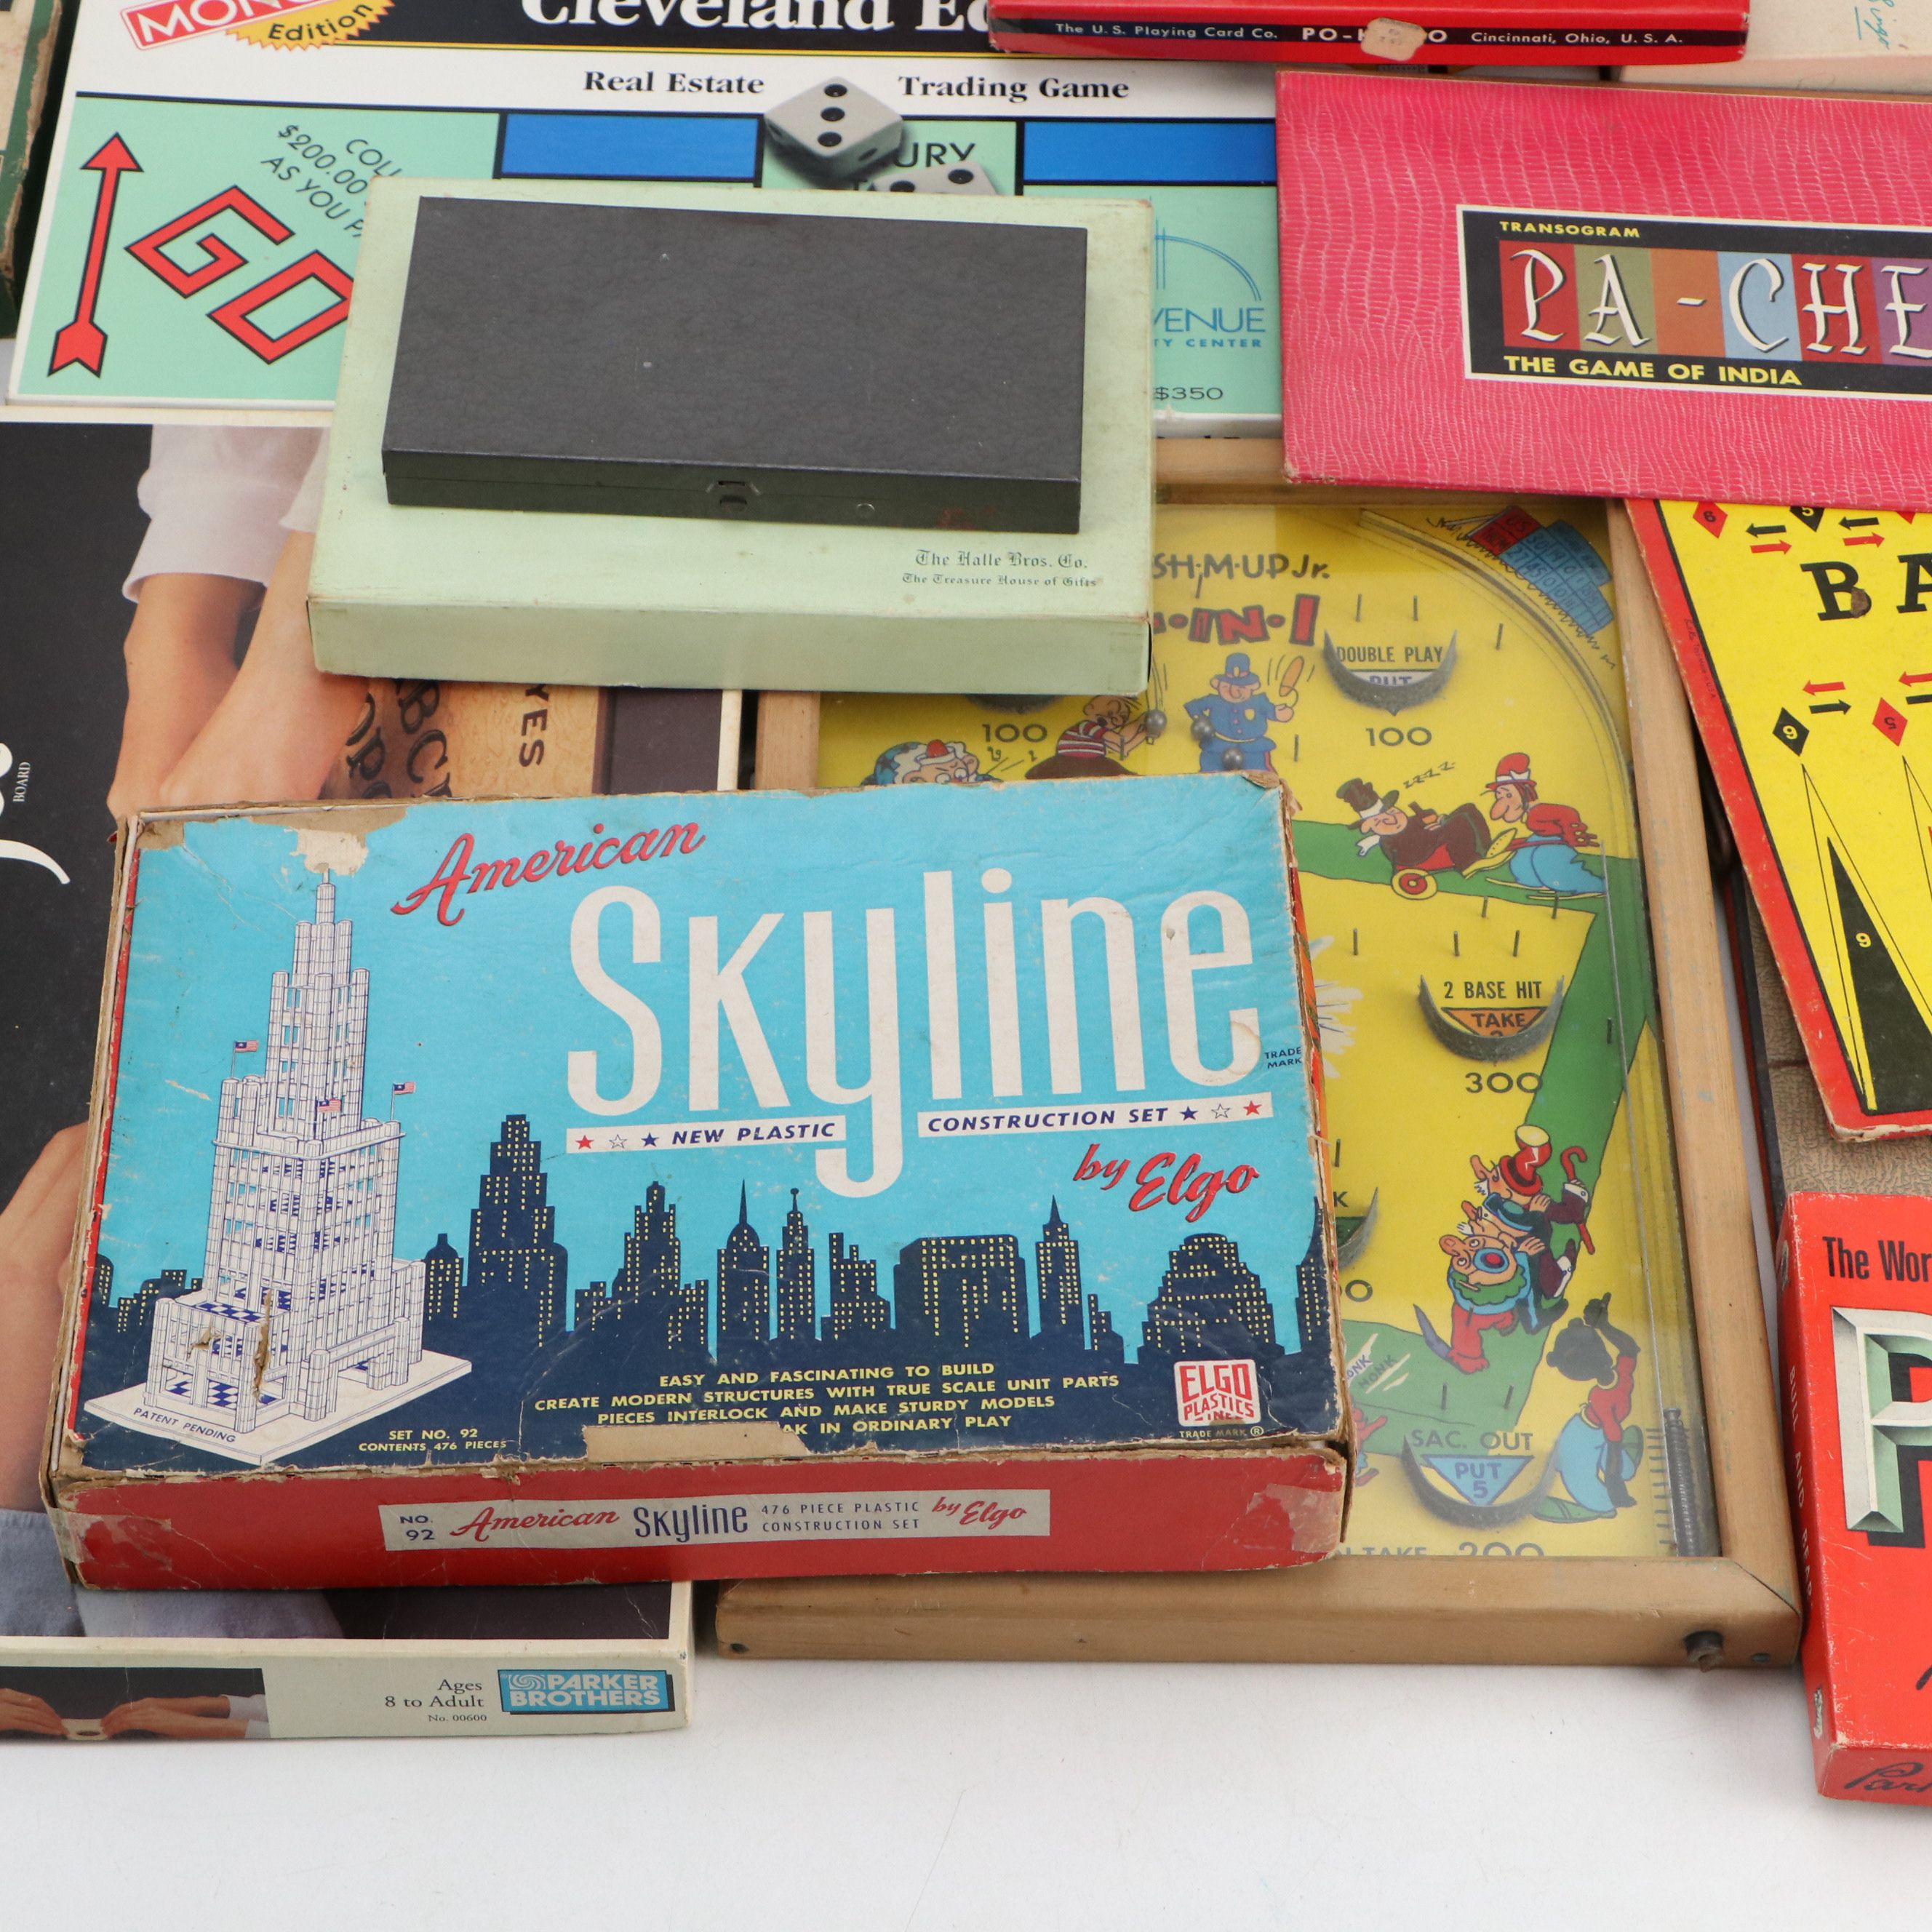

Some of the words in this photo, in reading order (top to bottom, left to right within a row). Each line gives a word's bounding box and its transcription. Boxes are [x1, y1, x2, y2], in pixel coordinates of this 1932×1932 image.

[268, 3, 374, 41] Edition
[1056, 23, 1083, 34] The
[1135, 26, 1197, 38] Playing
[1205, 27, 1244, 38] Card
[1252, 28, 1278, 39] Co.
[1471, 32, 1557, 44] Cincinnati,
[1565, 33, 1610, 44] Ohio,
[583, 71, 654, 92] Real
[667, 73, 765, 95] Estate
[898, 76, 1028, 103] Trading
[1039, 78, 1129, 100] Game
[278, 124, 368, 194] $200.00
[260, 157, 300, 180] AS
[295, 178, 351, 219] YOU
[1499, 221, 1640, 239] TRANSOGRAM
[124, 185, 356, 365] GO
[1186, 339, 1262, 348] CENTER
[1504, 355, 1556, 374] THE
[1568, 358, 1655, 379] GAME
[1668, 364, 1705, 382] OF
[1719, 365, 1803, 386] INDIA
[1154, 387, 1224, 401] $350
[915, 549, 949, 566] The
[957, 551, 1002, 567] Halle
[1008, 551, 1053, 567] Bros.
[1058, 553, 1087, 568] Co.
[902, 573, 927, 583] The
[933, 574, 992, 585] Treasure
[997, 575, 1039, 586] House
[1045, 575, 1058, 586] of
[1336, 646, 1395, 663] DOUBLE
[1404, 646, 1443, 663] PLAY
[518, 684, 550, 767] YES
[981, 723, 1047, 743] 100
[1365, 727, 1432, 746] 100
[12, 762, 31, 802] BOARD
[390, 822, 706, 927] American
[1443, 981, 1453, 999] 2
[1464, 981, 1506, 999] BASE
[1516, 981, 1541, 999] HIT
[1470, 1013, 1525, 1028] TAKE
[567, 868, 1261, 1198] Skyline
[1264, 1046, 1302, 1059] TRADE
[1267, 1057, 1302, 1069] MARK
[1465, 1072, 1543, 1093] 300
[671, 1128, 724, 1145] NEW
[737, 1122, 836, 1142] PLASTIC
[927, 1109, 1115, 1133] CONSTRUCTION
[1128, 1106, 1168, 1123] SET
[1073, 1143, 1131, 1190] by
[1128, 1151, 1261, 1223] Elgo
[1822, 1236, 1869, 1280] The
[1877, 1240, 1932, 1282] Wor
[660, 1374, 706, 1387] EASY
[717, 1372, 759, 1385] AND
[770, 1366, 894, 1384] FASCINATING
[905, 1365, 930, 1378] TO
[942, 1362, 994, 1376] BUILD
[1179, 1363, 1253, 1404] ELGO
[535, 1396, 600, 1411] CREATE
[611, 1392, 693, 1408] MODERN
[704, 1387, 815, 1404] STRUCTURES
[826, 1385, 876, 1400] WITH
[887, 1383, 931, 1397] TRUE
[942, 1380, 996, 1394] SCALE
[1007, 1377, 1051, 1392] UNIT
[1062, 1375, 1119, 1389] PARTS
[1789, 1365, 1800, 1432] BULL
[598, 1411, 655, 1424] PIECES
[667, 1407, 768, 1422] INTERLOCK
[780, 1404, 822, 1418] AND
[834, 1402, 887, 1416] MAKE
[898, 1399, 968, 1413] STURDY
[981, 1395, 1055, 1410] MODELS
[1183, 1393, 1255, 1421] PLASTICS
[134, 1408, 180, 1426] PATENT
[183, 1422, 236, 1443] PENDING
[820, 1420, 841, 1434] IN
[852, 1416, 954, 1433] ORDINARY
[965, 1414, 1012, 1429] PLAY
[388, 1430, 413, 1440] SET
[421, 1429, 450, 1440] NO.
[460, 1429, 479, 1438] 92
[1179, 1430, 1212, 1439] TRADE
[1411, 1429, 1467, 1449] SAC.
[1480, 1431, 1534, 1450] OUT
[359, 1442, 426, 1452] CONTENTS
[434, 1442, 458, 1450] 476
[465, 1440, 508, 1450] PIECES
[1454, 1462, 1502, 1480] PUT
[1795, 1450, 1805, 1508] AND
[1473, 1480, 1488, 1498] 5
[761, 1504, 791, 1514] 476
[801, 1503, 845, 1514] PIECE
[855, 1501, 919, 1513] PLASTIC
[932, 1496, 962, 1516] by
[959, 1501, 1027, 1530] Elgo
[399, 1515, 434, 1524] NO.
[449, 1506, 620, 1542] American
[633, 1504, 749, 1543] Skyline
[762, 1519, 883, 1532] CONSTRUCTION
[893, 1518, 920, 1530] SET
[405, 1529, 435, 1541] 92
[438, 1678, 482, 1692] Ages
[548, 1674, 658, 1691] PARKER
[385, 1696, 396, 1707] 8
[404, 1697, 423, 1707] to
[428, 1695, 484, 1707] Adult
[511, 1690, 661, 1707] BROTHERS
[452, 1714, 487, 1722] 00600
